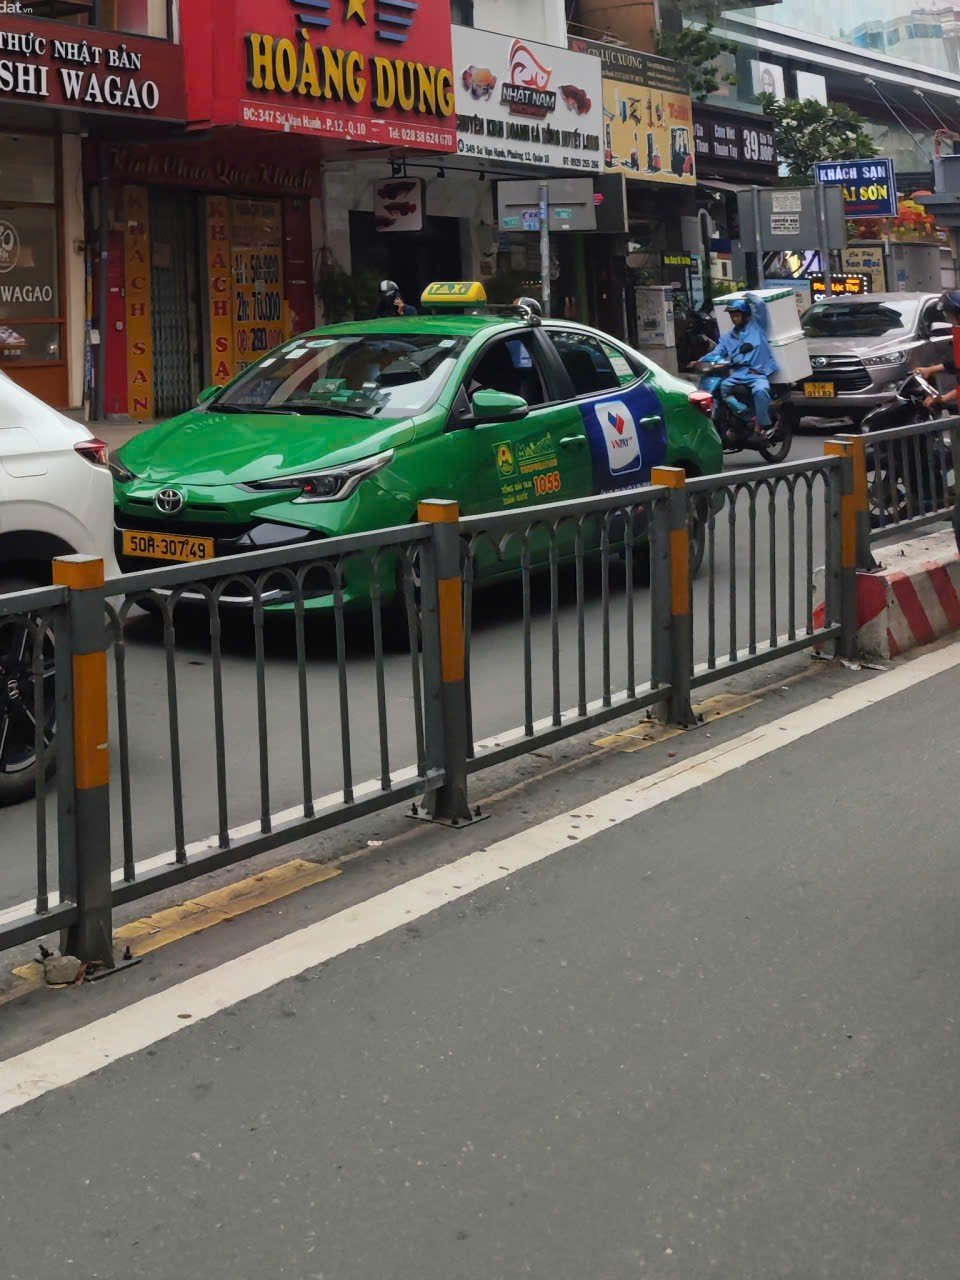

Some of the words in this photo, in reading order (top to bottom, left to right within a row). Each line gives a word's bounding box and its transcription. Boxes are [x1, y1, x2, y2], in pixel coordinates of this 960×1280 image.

[53, 40, 103, 66] NHẬT
[108, 44, 142, 70] BẢN
[248, 28, 367, 104] HOÀNG
[373, 56, 456, 118] DUNG
[60, 68, 160, 110] WAGAO
[532, 94, 556, 108] NAM
[258, 108, 274, 122] 347
[348, 122, 366, 136] Q.10
[401, 128, 416, 141] 028
[416, 130, 425, 142] 38
[425, 131, 440, 144] 624
[531, 123, 541, 143] CÁ
[465, 145, 476, 154] 349
[743, 129, 759, 160] 39
[820, 165, 858, 181] KHÁCH
[862, 166, 886, 183] SẠN
[860, 183, 888, 200] SƠN
[1, 285, 53, 303] WAGAO
[252, 292, 281, 321] 70.000
[533, 471, 561, 496] 1055
